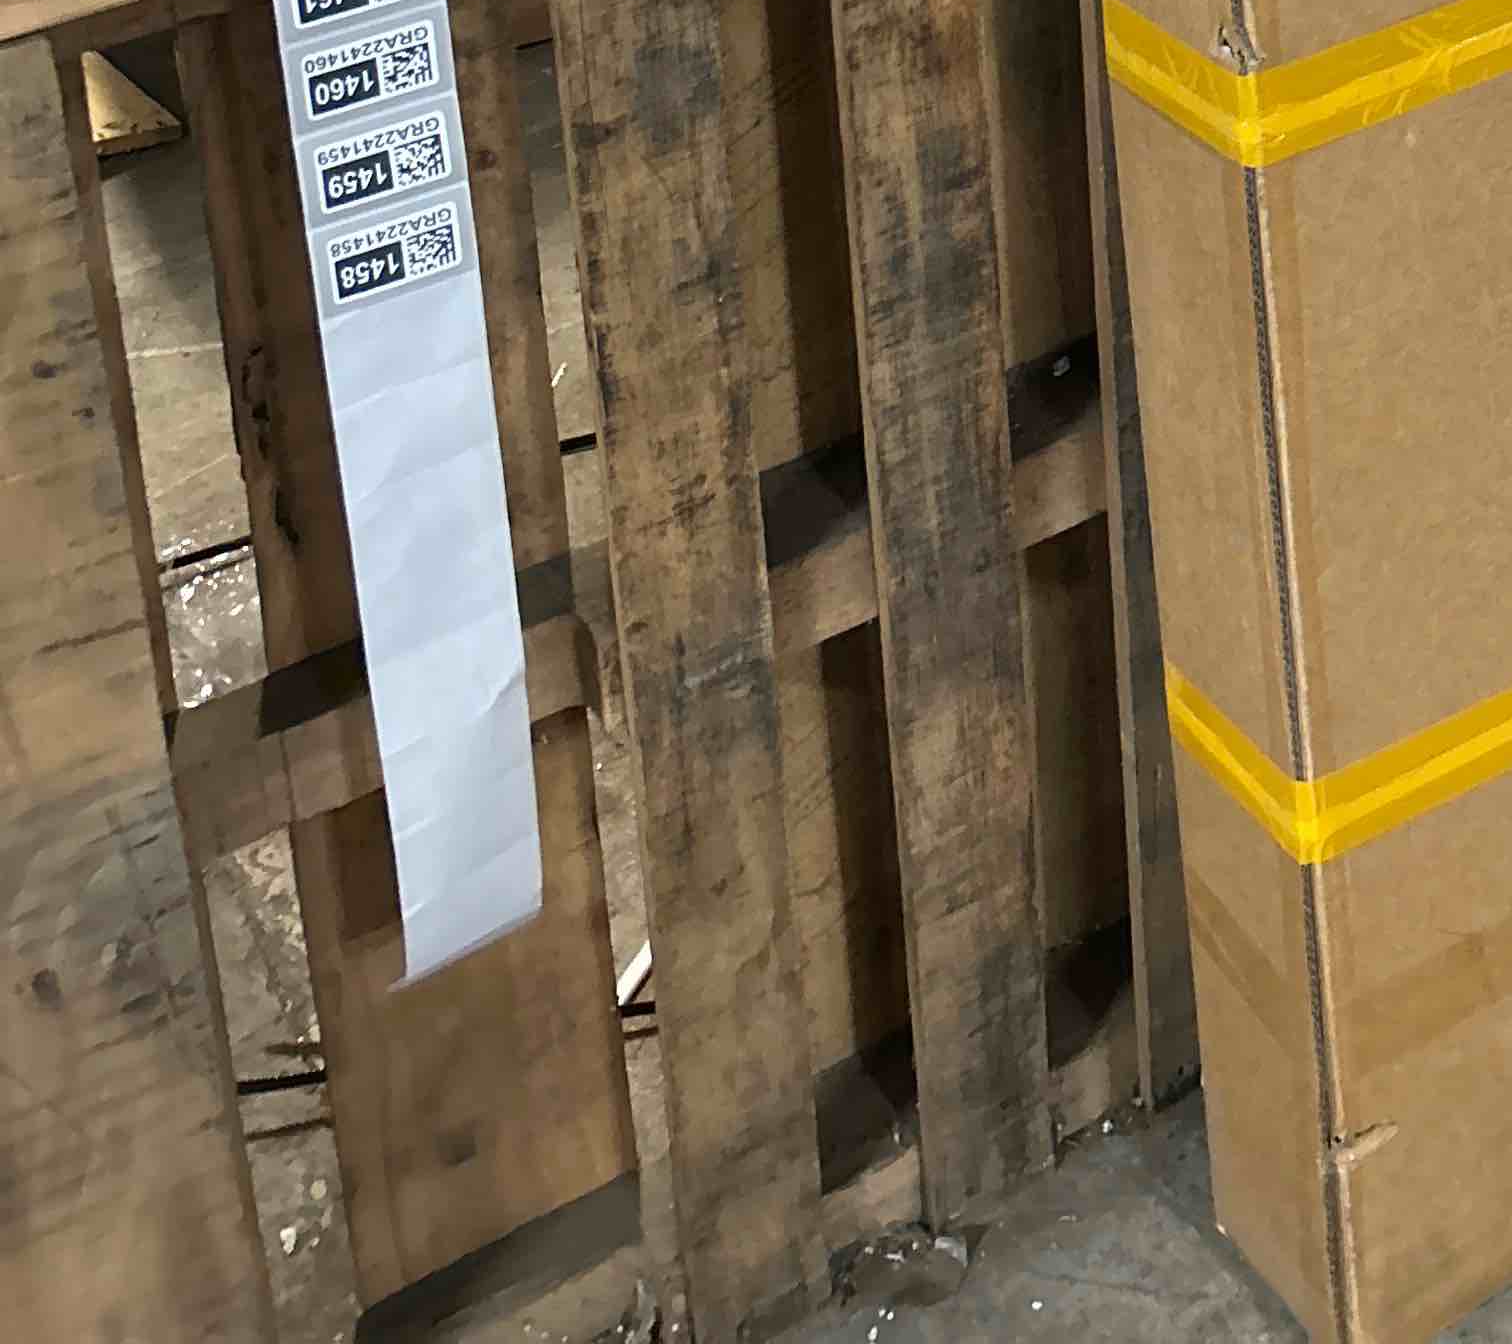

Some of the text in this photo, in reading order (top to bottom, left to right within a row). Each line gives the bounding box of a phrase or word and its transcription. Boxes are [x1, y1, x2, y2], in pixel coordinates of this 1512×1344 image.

[304, 26, 428, 74] GRA2241460
[314, 69, 375, 105] 1460
[317, 116, 440, 166] GRA2241459
[328, 161, 388, 199] 1459
[330, 207, 452, 258] GRA2241458
[340, 252, 400, 289] 1458
